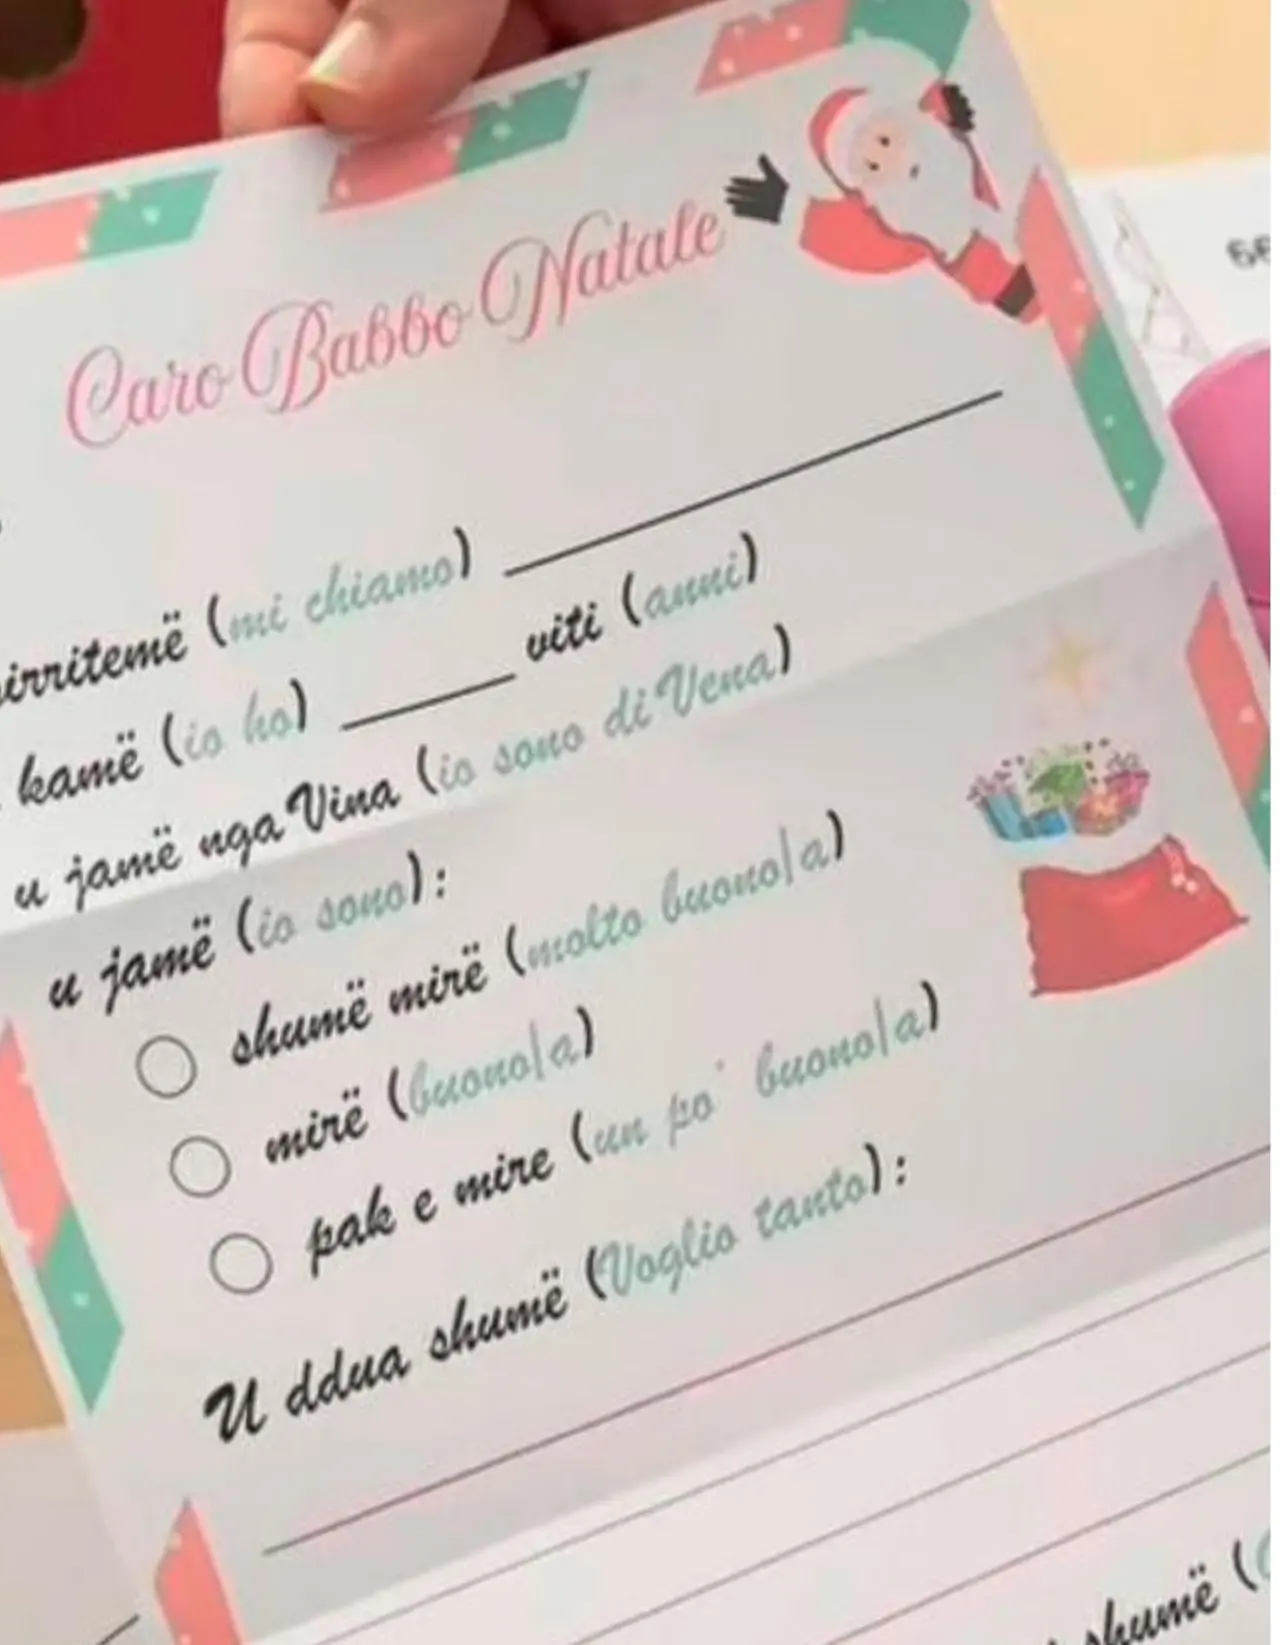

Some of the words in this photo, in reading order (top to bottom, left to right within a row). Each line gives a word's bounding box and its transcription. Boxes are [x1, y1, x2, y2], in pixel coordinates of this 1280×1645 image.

[65, 344, 234, 450] Caro
[240, 293, 470, 415] Babbo
[480, 199, 727, 345] Natale
[17, 731, 143, 806] kamë
[162, 712, 224, 766] (io
[243, 679, 308, 746] ho)
[526, 601, 603, 662] viti
[622, 531, 757, 627] (anni)
[207, 594, 288, 647] (mi
[305, 526, 470, 623] chiamo)
[14, 876, 50, 910] u
[65, 826, 183, 913] jamë
[199, 823, 285, 867] nga
[286, 776, 400, 834] Vina
[415, 744, 476, 796] (io
[493, 720, 585, 777] sono
[602, 685, 652, 739] di
[655, 623, 791, 719] Vena)
[48, 972, 82, 1009] u
[100, 916, 217, 1016] jamë
[236, 896, 298, 954] (io
[230, 977, 372, 1067] shumë
[388, 941, 489, 1017] mirë
[505, 902, 646, 977] (molto
[265, 1086, 369, 1166] mirë
[306, 1183, 397, 1279] pak
[413, 1183, 440, 1223] e
[453, 1146, 555, 1204] mire
[570, 1110, 649, 1164] (un
[203, 1376, 267, 1448] U
[284, 1346, 411, 1419] ddua
[428, 1267, 571, 1362] shumë
[583, 1218, 737, 1302] (Voglio
